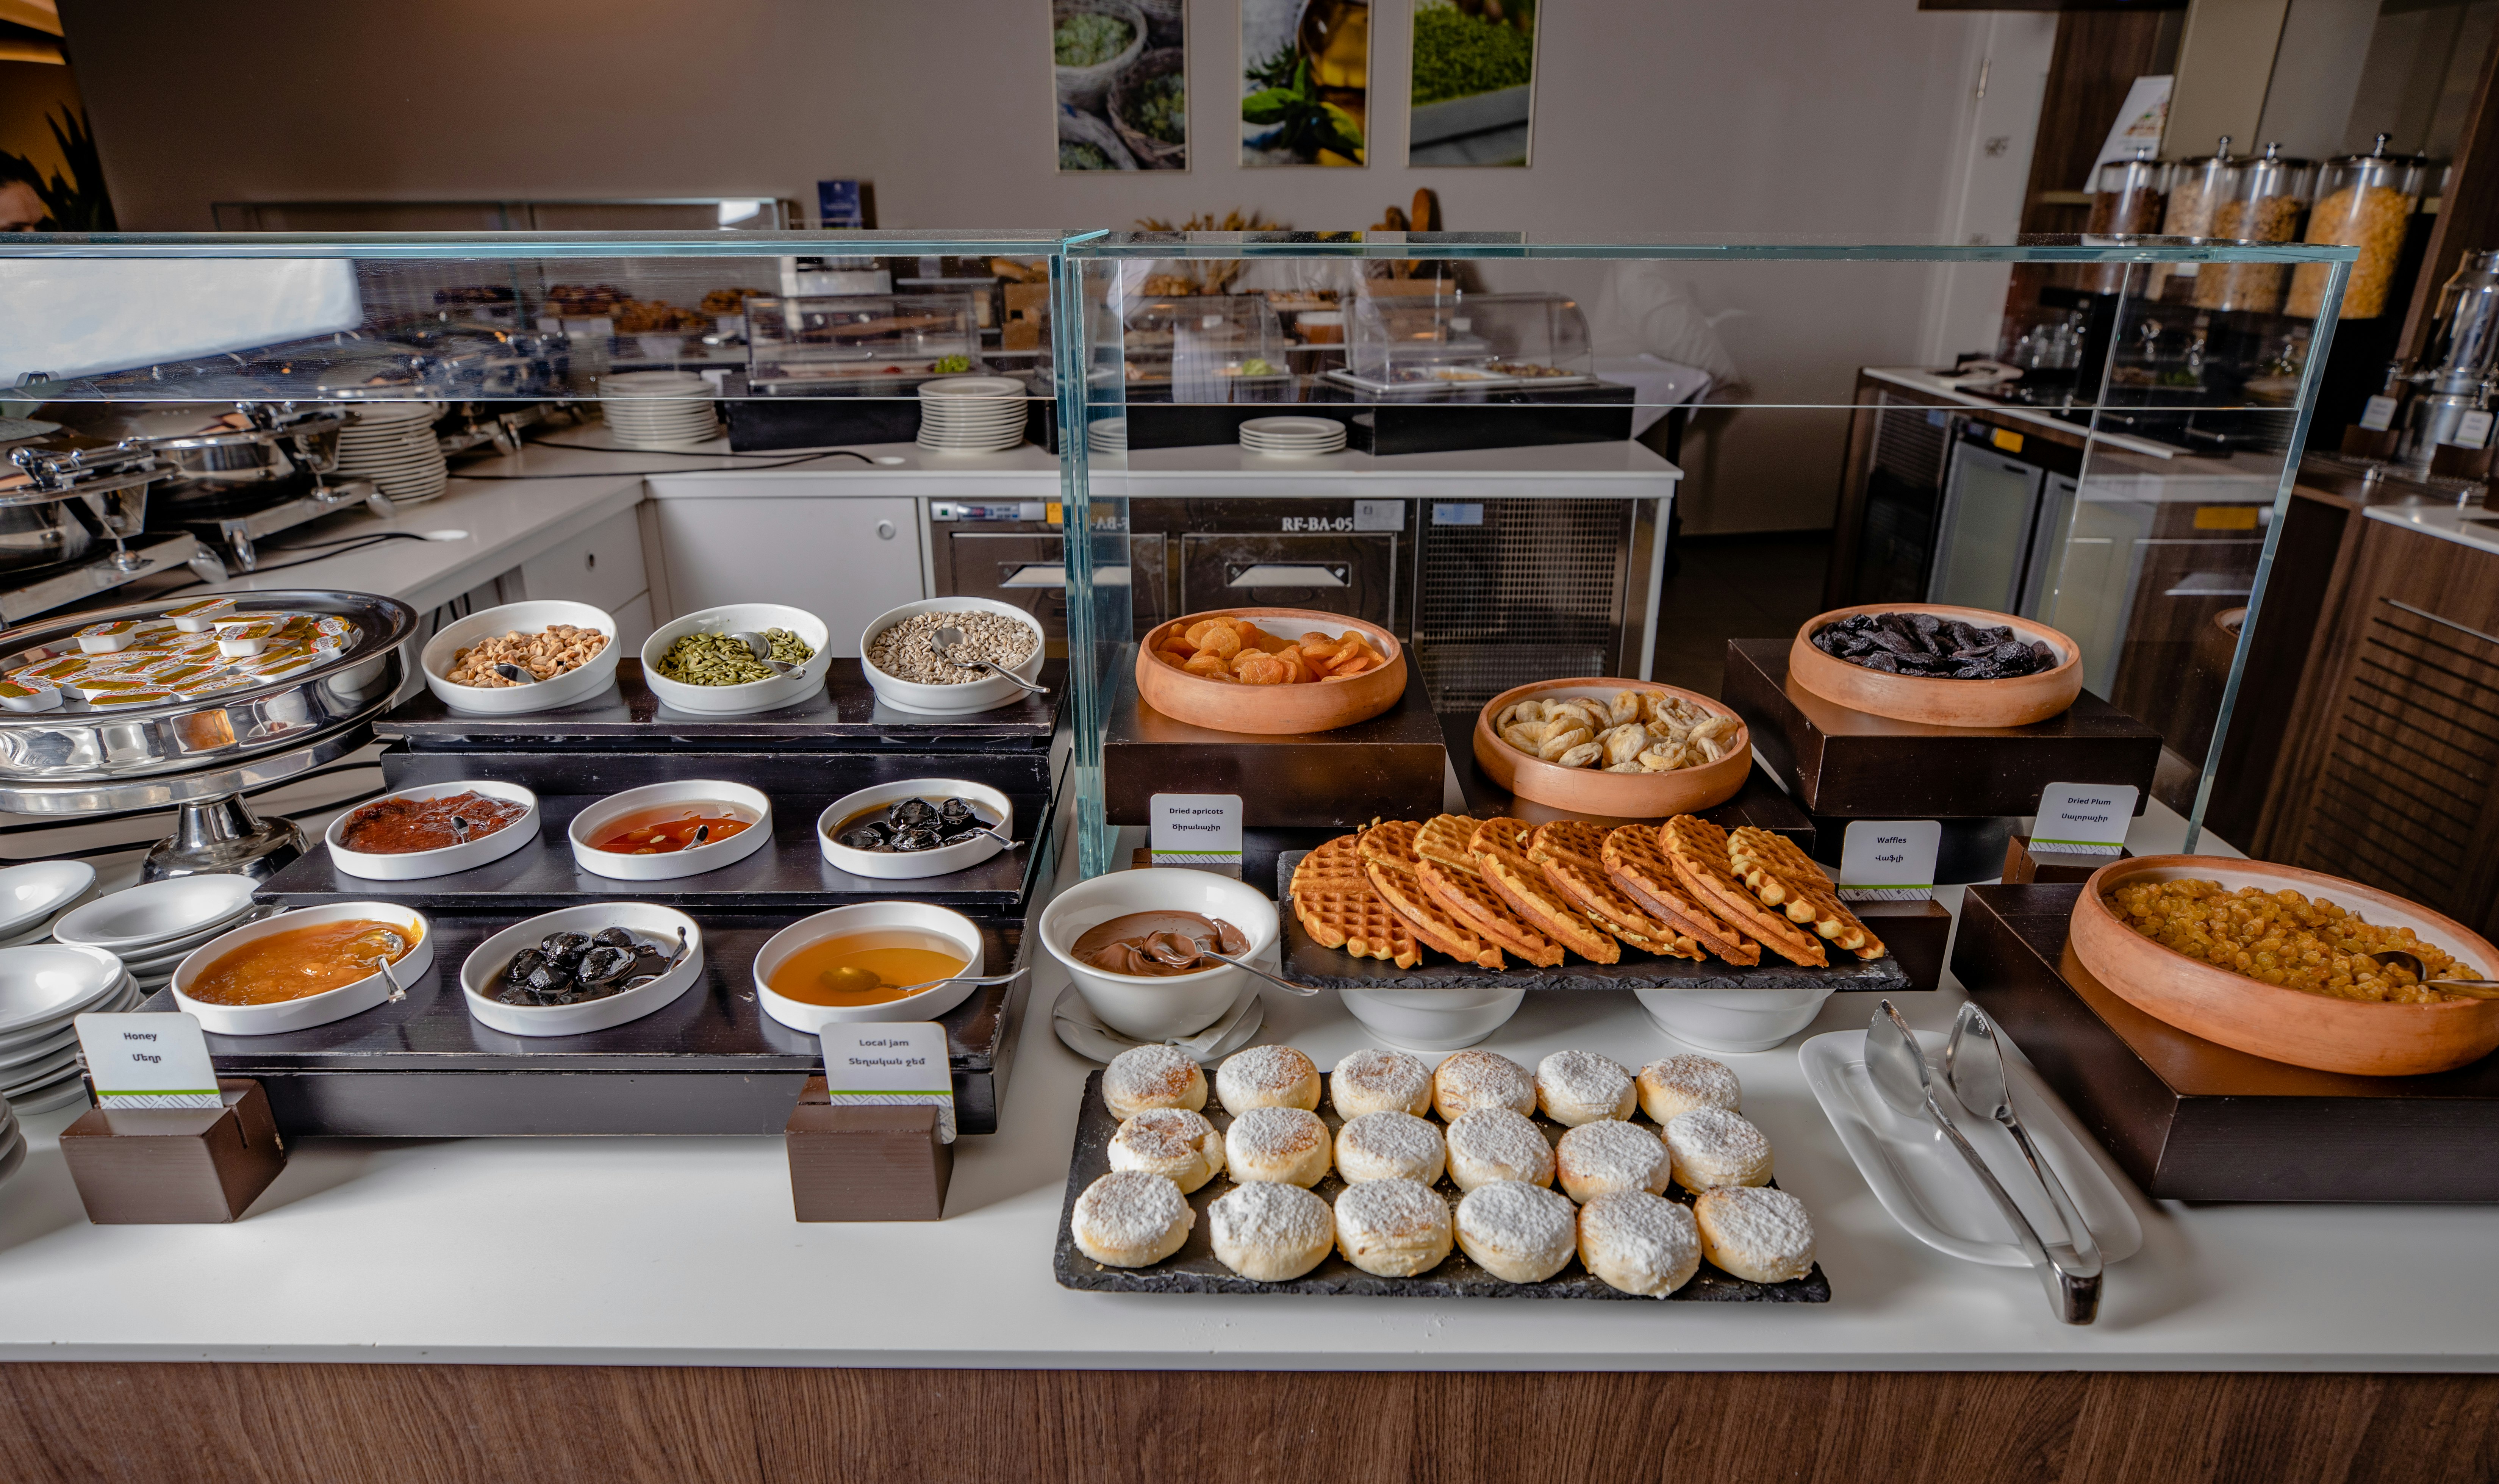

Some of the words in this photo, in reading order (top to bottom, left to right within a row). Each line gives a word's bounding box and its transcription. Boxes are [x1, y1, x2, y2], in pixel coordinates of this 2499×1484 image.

[1281, 517, 1353, 531] RF-BA-05
[2061, 813, 2108, 823] Սալորաչիր
[1875, 854, 1903, 863] Վաֆլի
[124, 1032, 157, 1042] Honey
[889, 1040, 909, 1048] jam
[132, 1054, 161, 1063] Մեղր
[849, 1058, 902, 1066] Տեղական
[906, 1058, 925, 1067] ջեմ
